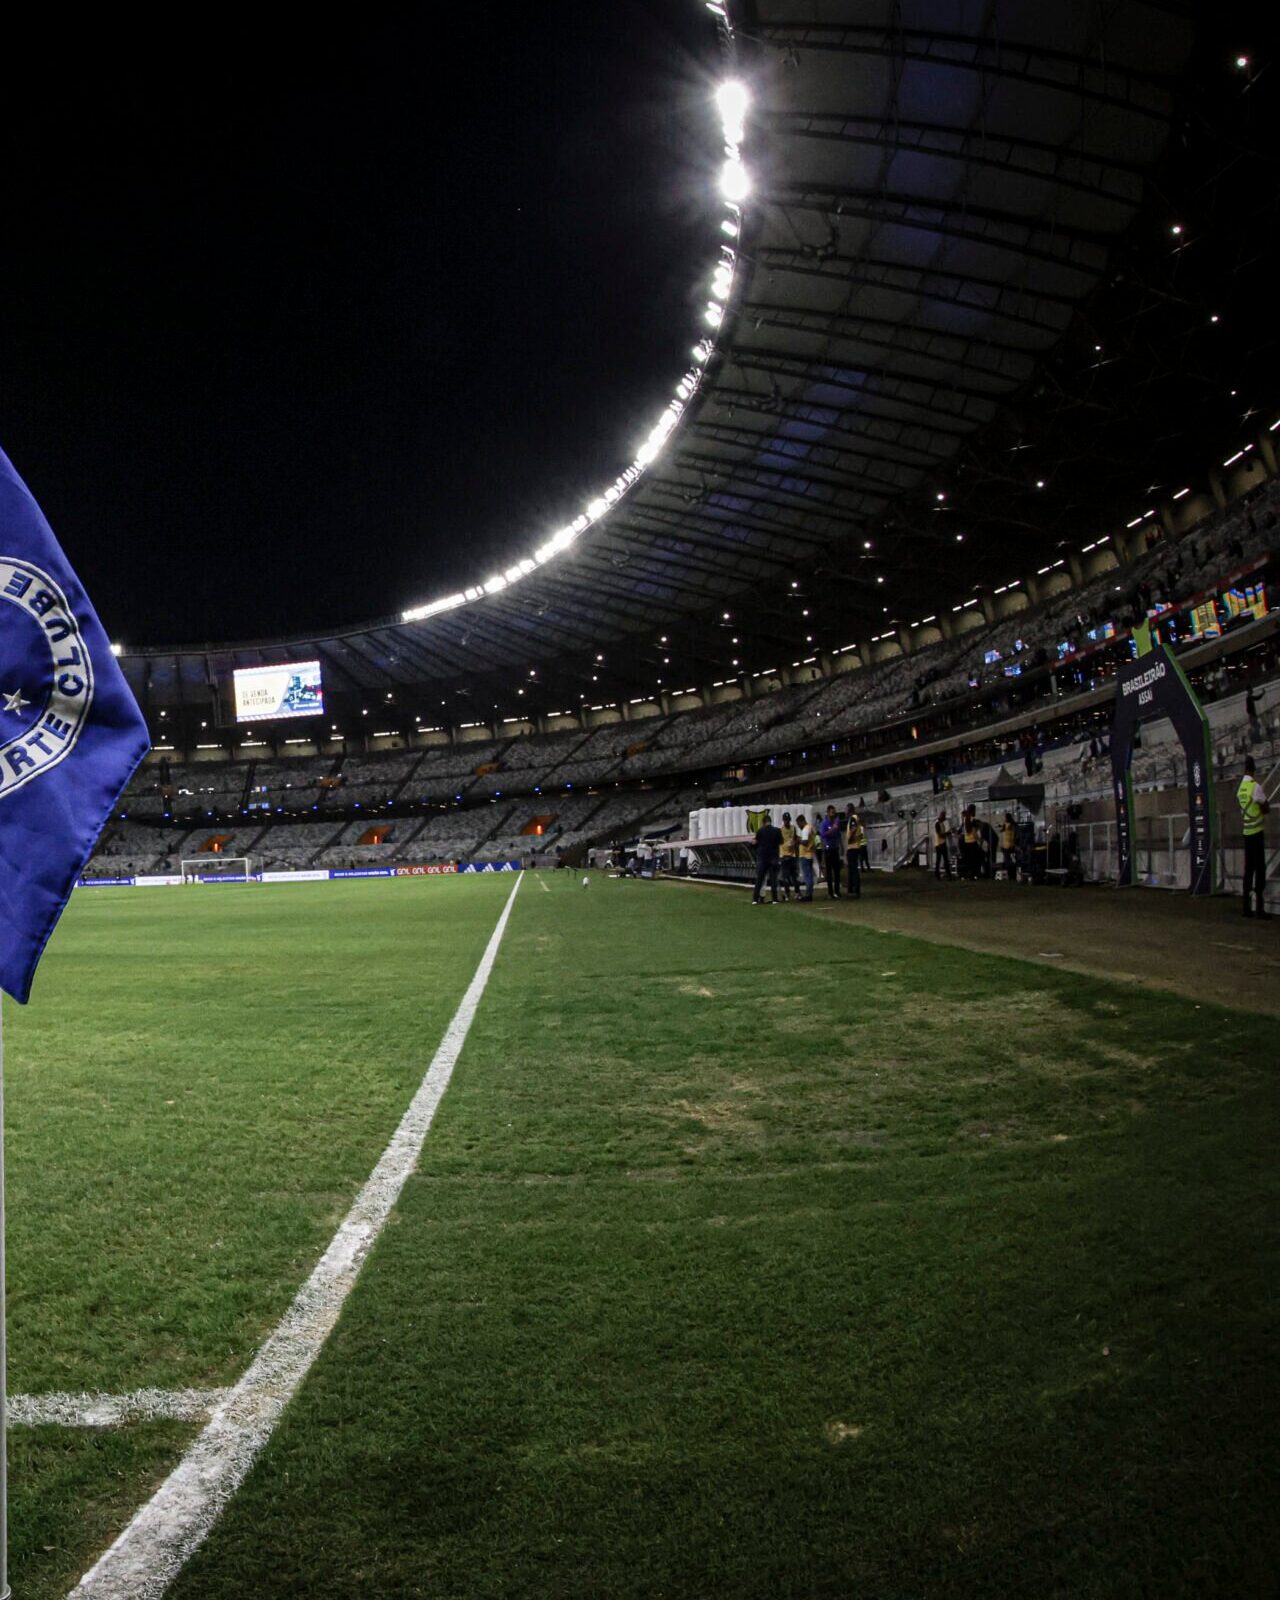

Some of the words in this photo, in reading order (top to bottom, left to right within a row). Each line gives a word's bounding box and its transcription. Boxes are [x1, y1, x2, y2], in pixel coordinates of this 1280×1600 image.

[4, 570, 84, 696] CLUBE
[1122, 662, 1166, 696] BRASILEIRÃO
[427, 866, 441, 874] GOL
